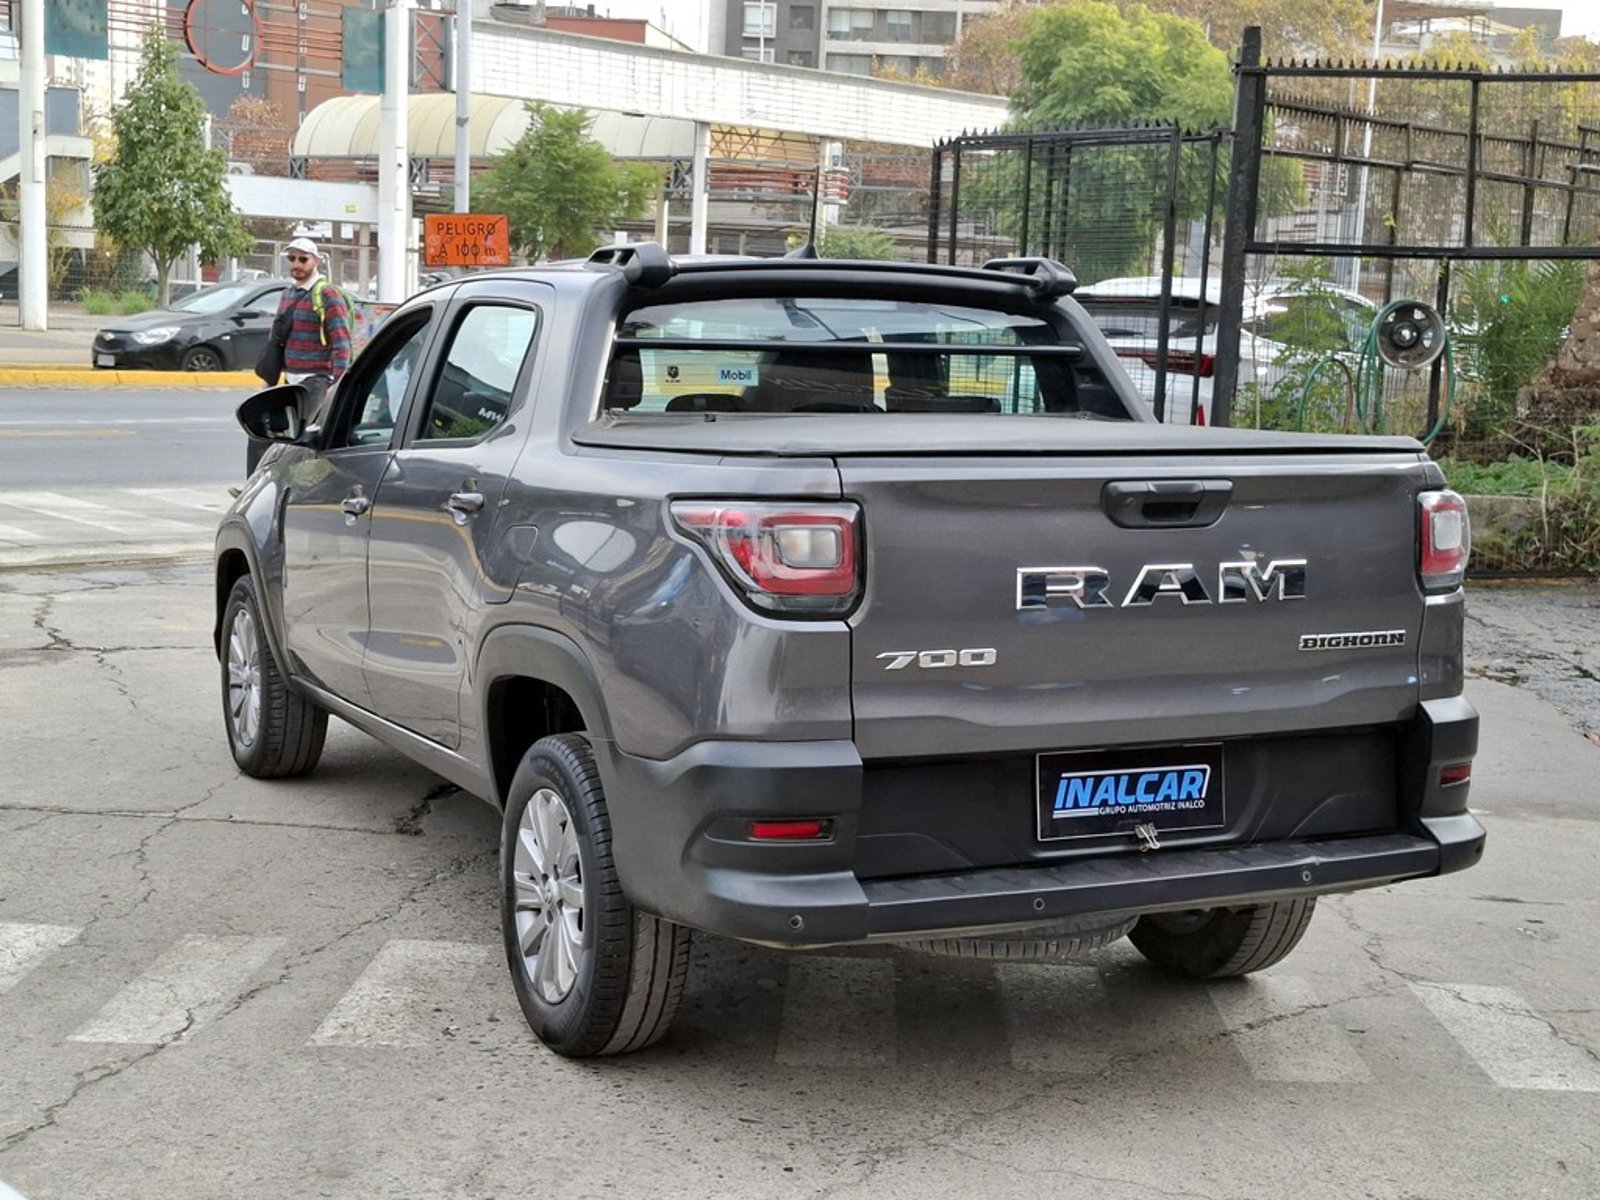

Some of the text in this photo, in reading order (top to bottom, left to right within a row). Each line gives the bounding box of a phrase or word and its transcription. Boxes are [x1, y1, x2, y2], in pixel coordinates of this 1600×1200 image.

[437, 223, 496, 235] PELIGRO
[438, 243, 496, 257] A 100 m
[720, 369, 752, 381] Mobil
[1016, 559, 1308, 610] RAM
[1299, 630, 1406, 650] BIGHORN
[876, 647, 997, 670] 700
[1054, 770, 1204, 808] INALCAR
[1099, 799, 1205, 816] GRUPO AUTOMOTRIZ INALCO
